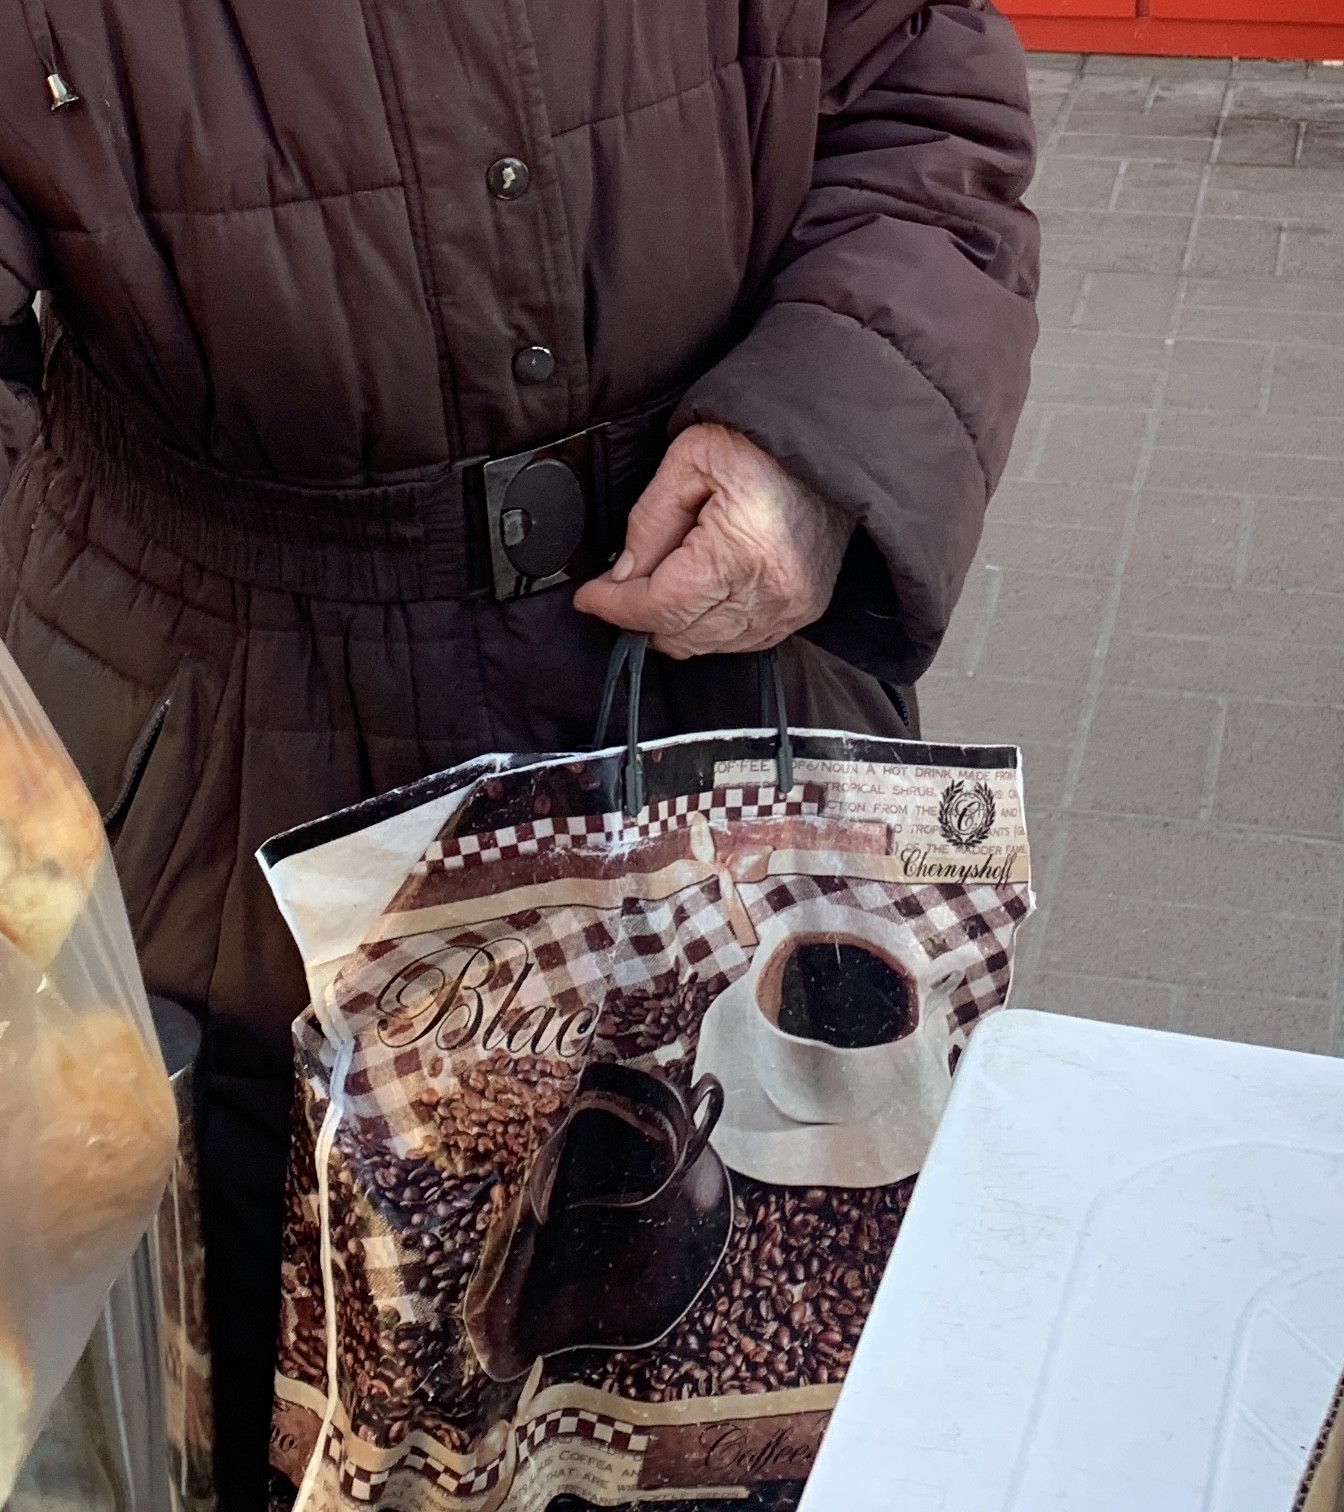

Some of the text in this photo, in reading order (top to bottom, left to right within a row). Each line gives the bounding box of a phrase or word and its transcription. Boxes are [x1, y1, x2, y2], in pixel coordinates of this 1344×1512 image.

[866, 762, 876, 776] A
[882, 765, 908, 777] HOT
[915, 767, 952, 779] DRINK
[958, 770, 990, 781] MADE
[824, 781, 885, 796] TROPICAL
[827, 799, 866, 813] CTION
[873, 802, 908, 815] FROM
[915, 805, 938, 817] THE
[987, 826, 1010, 837] ANTS
[927, 843, 950, 854] THE
[900, 848, 1018, 889] Chernyshoff
[376, 937, 599, 1058] Blac
